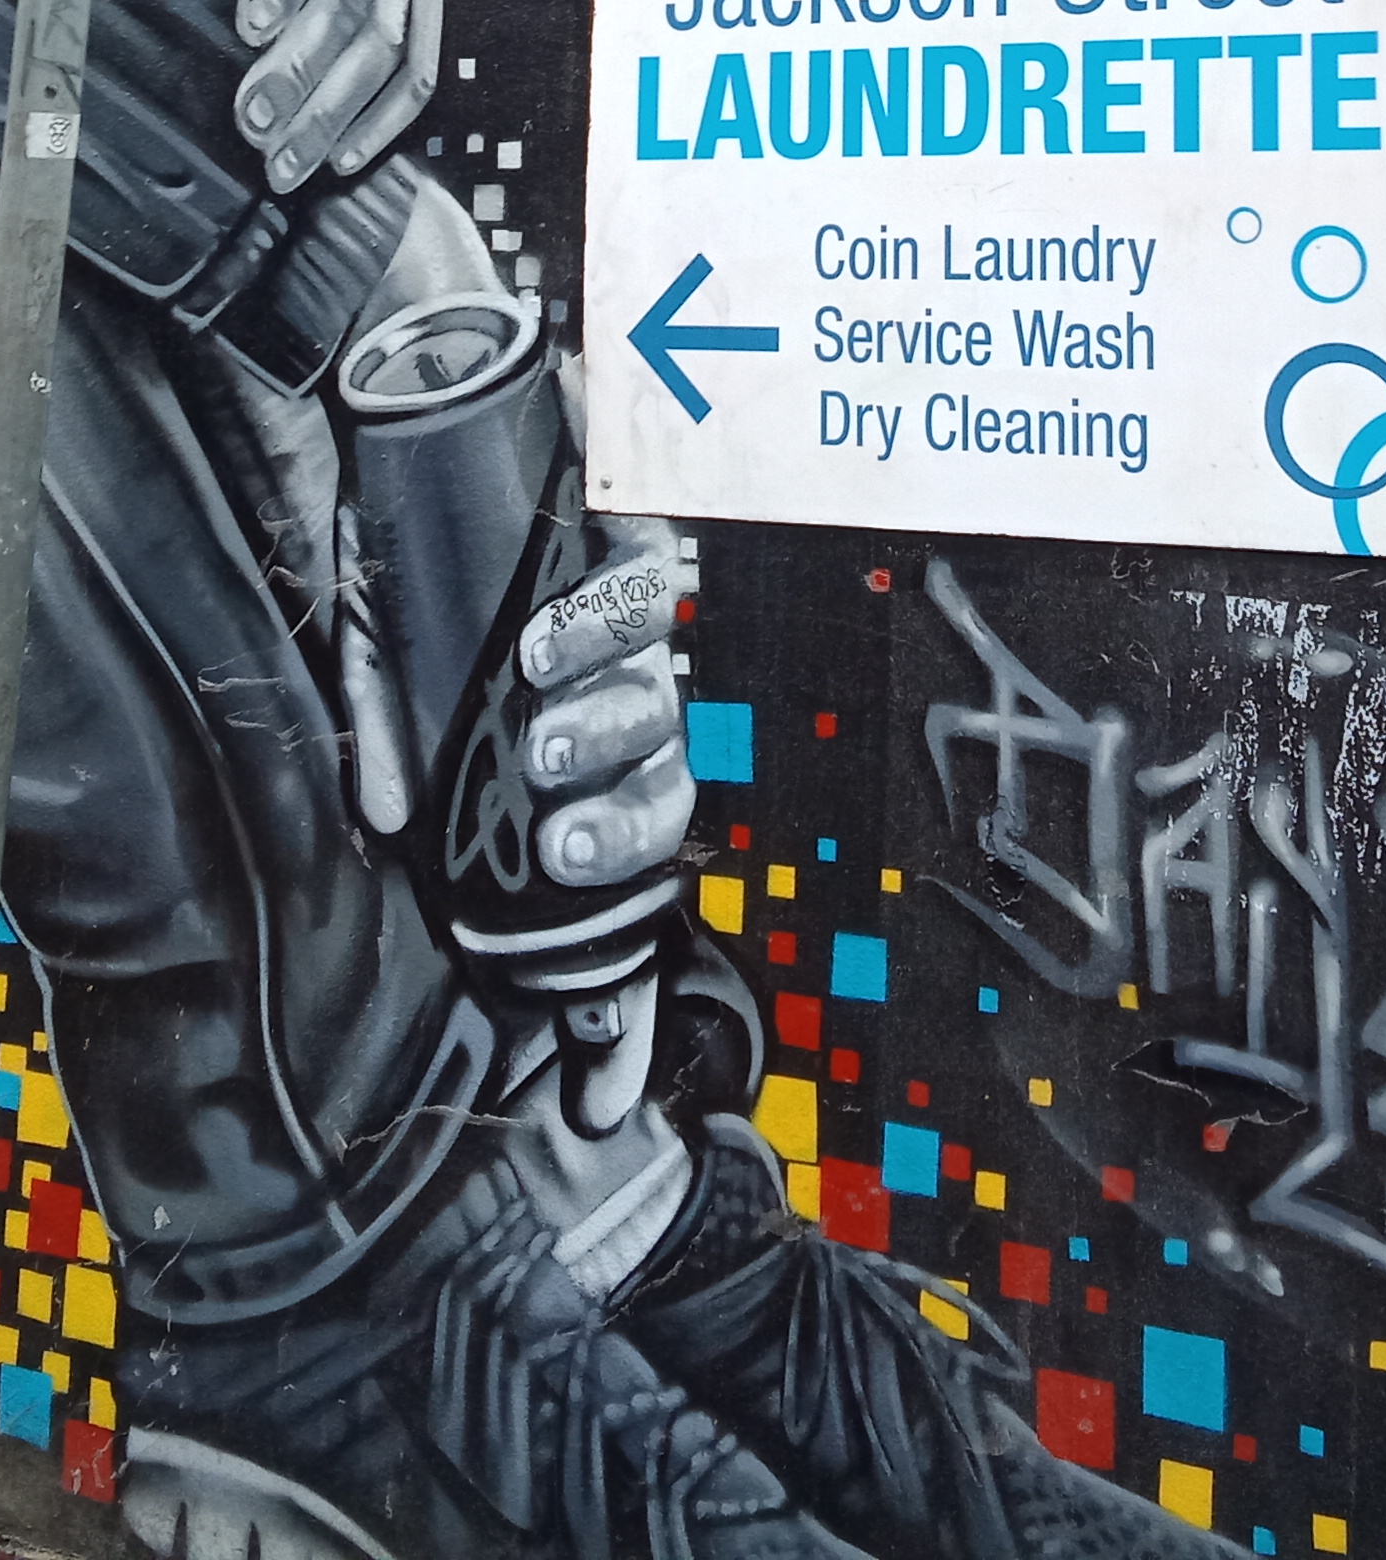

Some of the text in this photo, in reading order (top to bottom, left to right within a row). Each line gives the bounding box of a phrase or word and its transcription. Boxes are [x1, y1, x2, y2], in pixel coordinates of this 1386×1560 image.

[635, 30, 1383, 161] LAUNDRETTE
[813, 223, 1157, 295] Coin Laundry
[812, 306, 1156, 371] Service Wash
[819, 389, 1149, 473] Dry Cleaning
